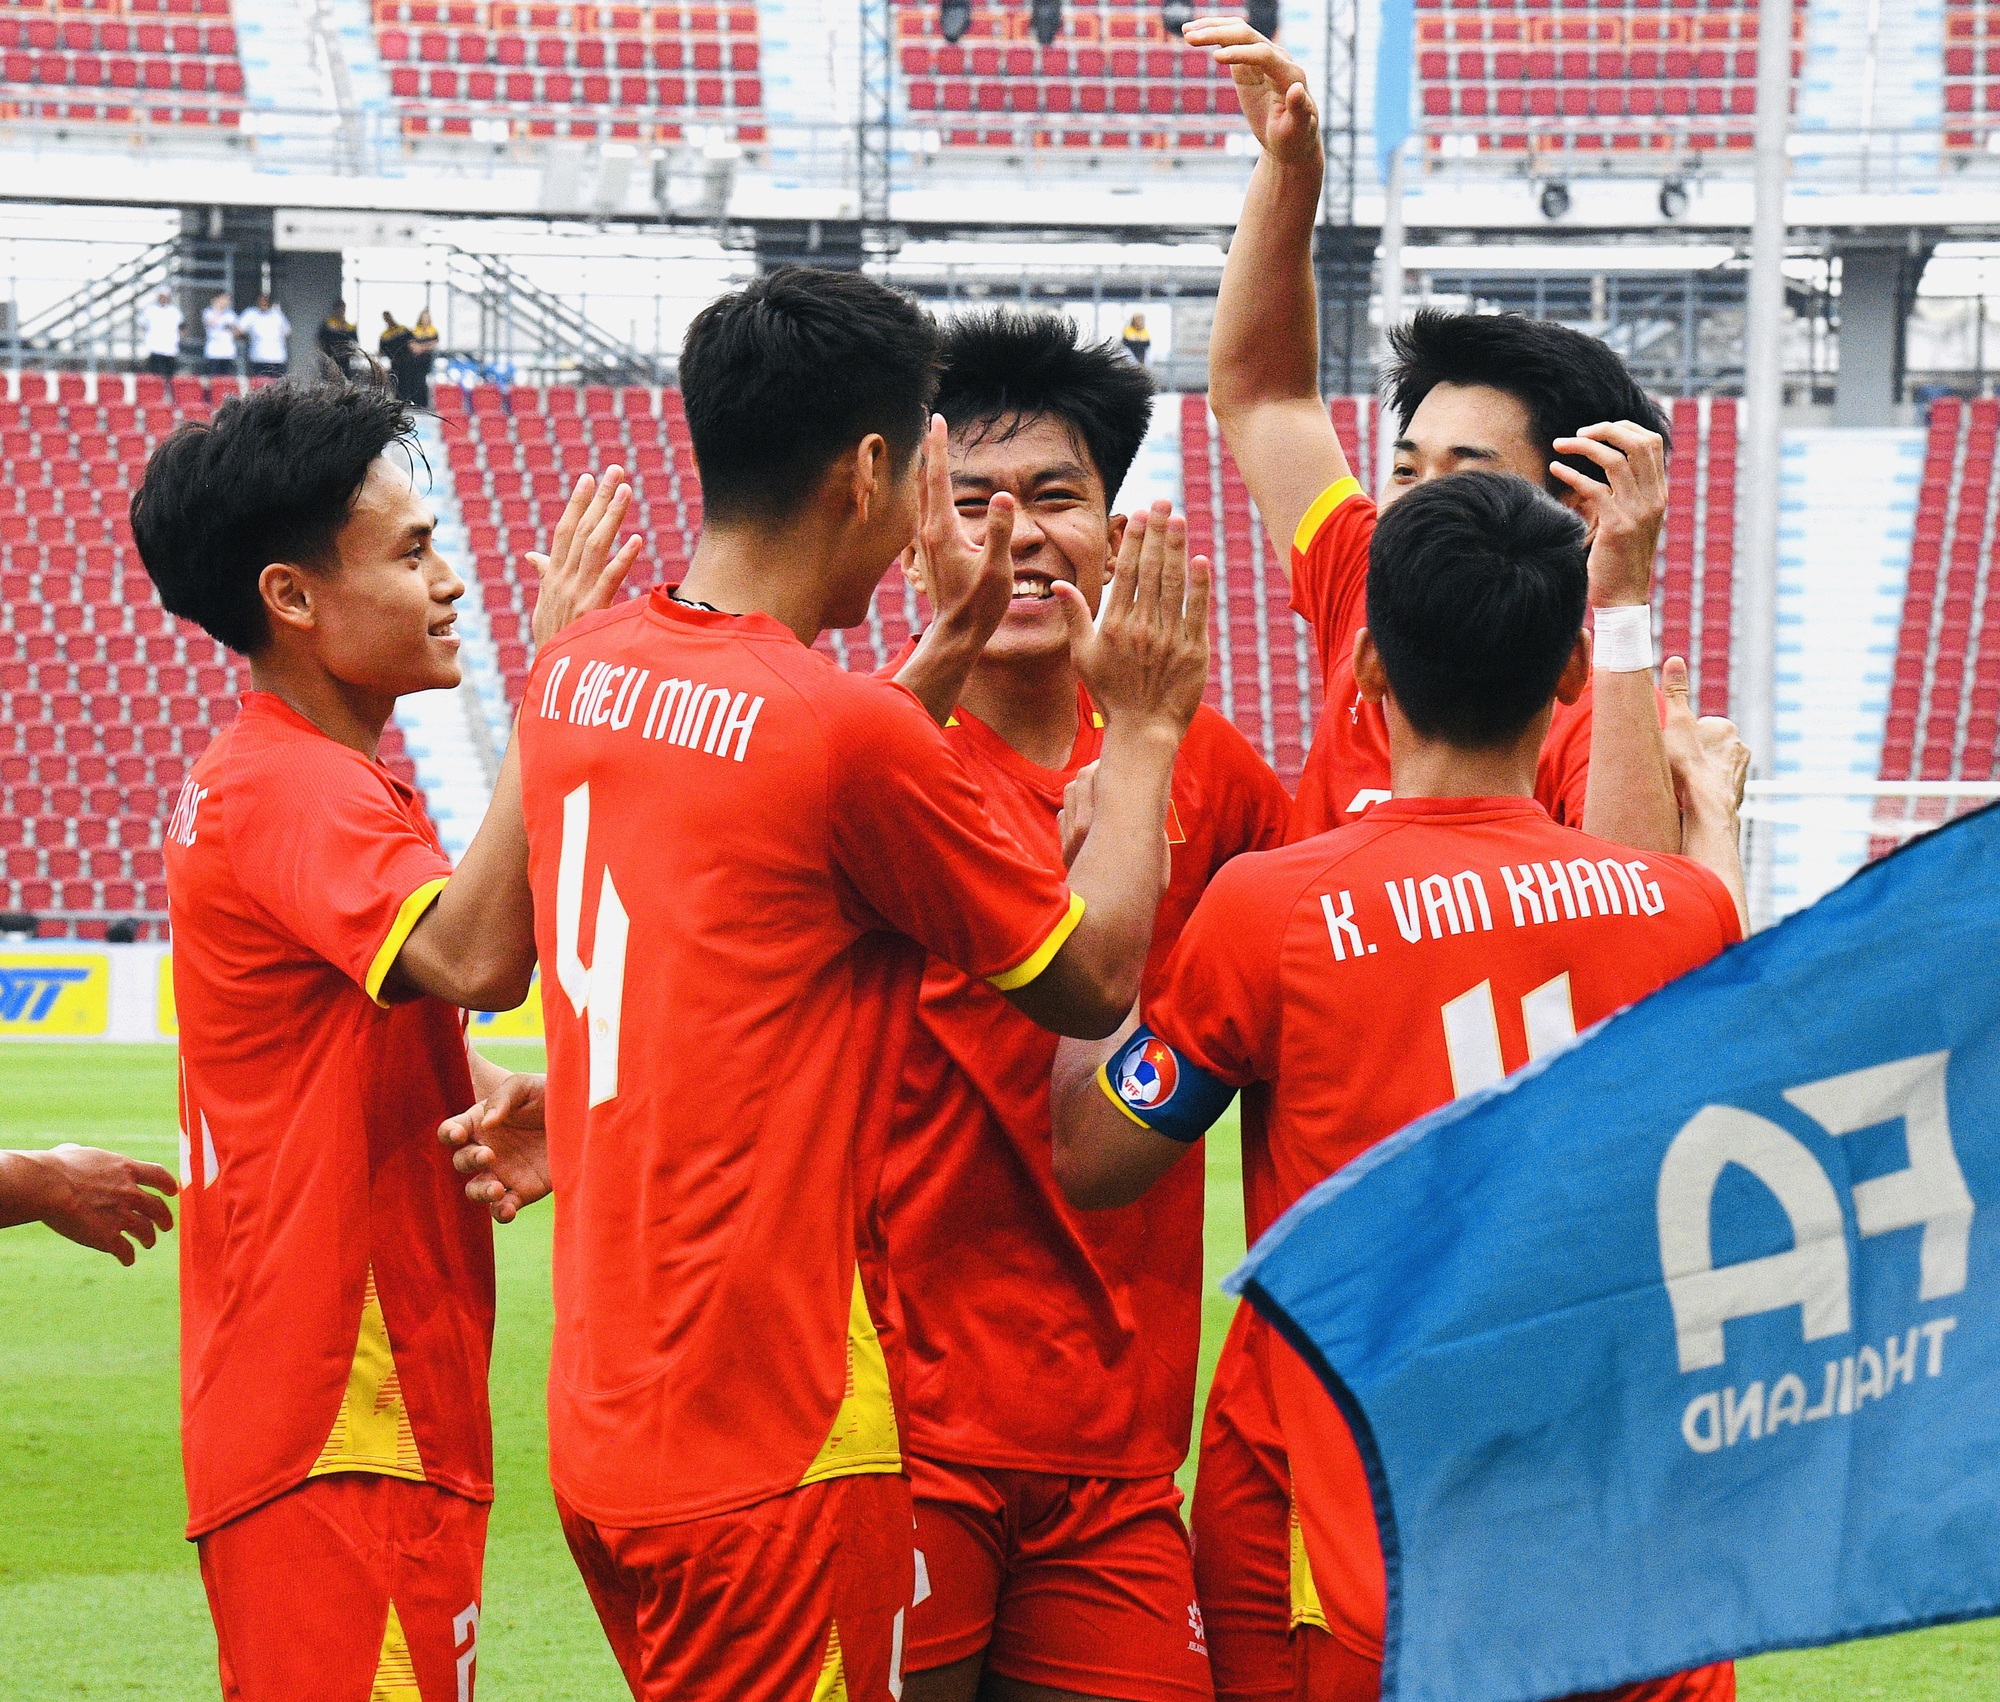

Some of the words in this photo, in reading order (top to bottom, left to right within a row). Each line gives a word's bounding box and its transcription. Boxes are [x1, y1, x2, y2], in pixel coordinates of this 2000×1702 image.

[568, 659, 650, 731] HIEU
[641, 677, 765, 763] MINH
[556, 781, 630, 1109] 4
[1320, 889, 1378, 961] K.
[1385, 869, 1494, 944] VAN
[1499, 857, 1665, 927] KHANG
[1124, 1079, 1141, 1097] VFF
